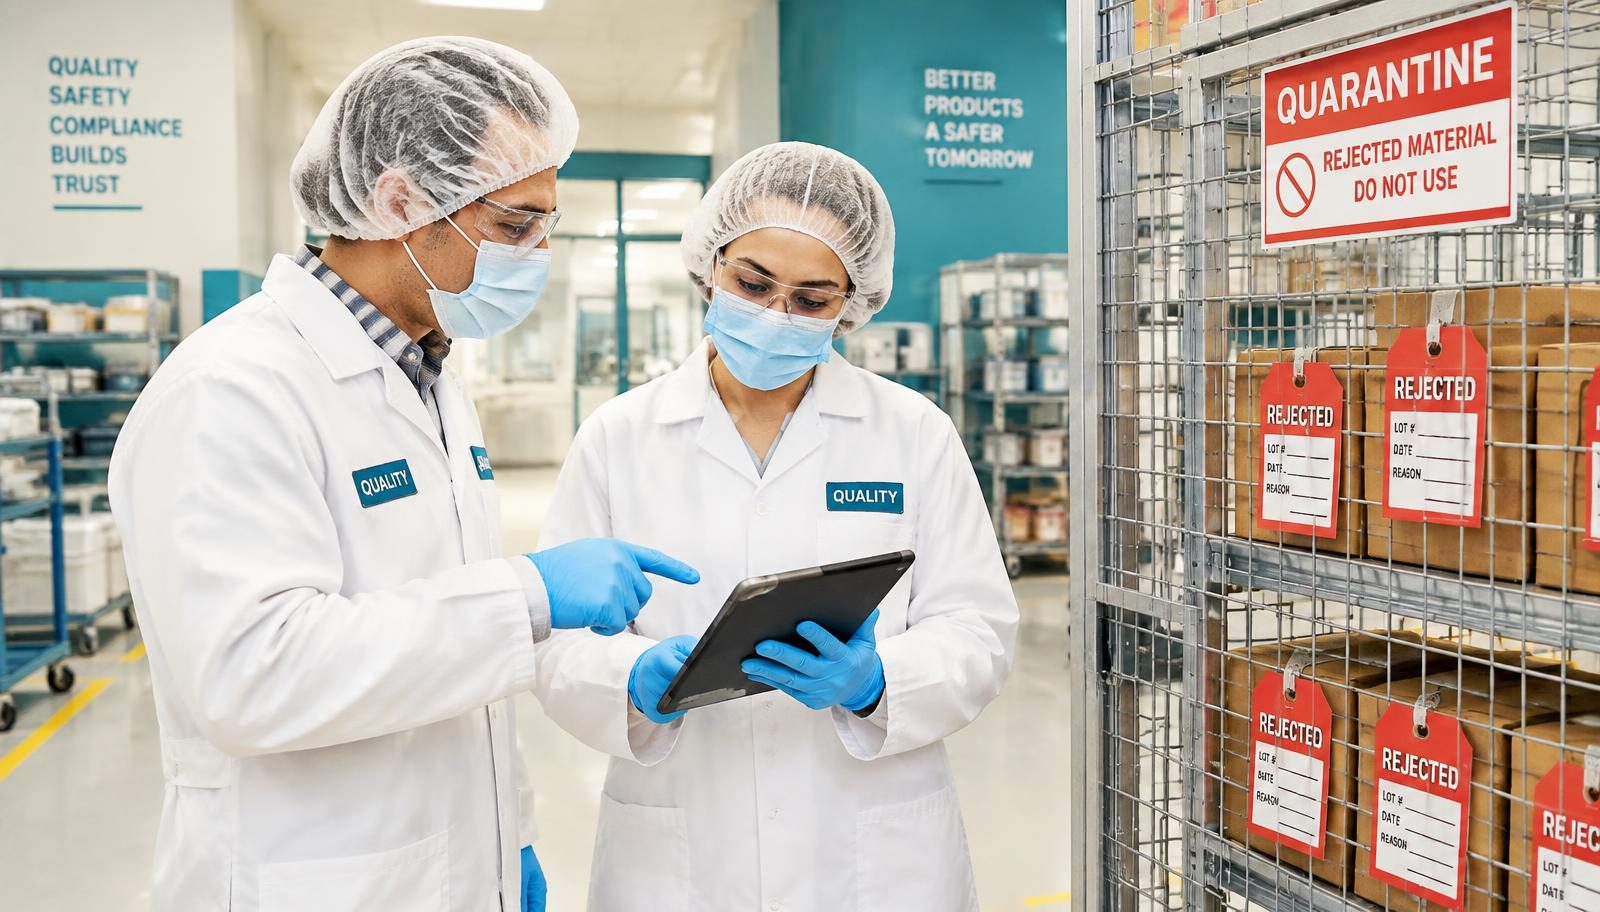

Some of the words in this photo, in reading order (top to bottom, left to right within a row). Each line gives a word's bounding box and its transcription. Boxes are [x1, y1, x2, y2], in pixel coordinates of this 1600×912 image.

[48, 56, 139, 77] QUALITY
[924, 68, 996, 91] BETTER
[1277, 36, 1494, 126] QUARANTINE
[49, 86, 130, 105] SAFETY
[924, 94, 1024, 119] PRODUCTS
[50, 116, 183, 137] COMPLIANCE
[925, 121, 940, 141] A
[944, 122, 1004, 143] SAFER
[51, 145, 127, 165] BUILDS
[1323, 138, 1402, 172] REJECTED
[1408, 121, 1497, 158] MATERIAL
[925, 147, 1034, 169] TOMORROW
[52, 174, 120, 194] TRUST
[1354, 177, 1377, 203] DO
[1383, 172, 1417, 198] NOT
[1423, 165, 1458, 193] USE
[1395, 375, 1476, 401] REJECTED
[1267, 404, 1334, 428] REJECTED
[1394, 422, 1408, 433] LOT
[1267, 444, 1280, 454] LOT
[360, 470, 409, 496] QUALITY
[1392, 467, 1422, 480] REASON
[833, 489, 898, 504] QUALITY
[1259, 711, 1322, 749] REJECTED
[1259, 751, 1270, 763] LOT
[1382, 747, 1459, 791] REJECTED
[1382, 790, 1396, 803] LOT
[1381, 810, 1401, 826] DATE
[1380, 832, 1408, 850] REASON
[1543, 860, 1559, 875] LOT
[1542, 884, 1565, 901] DATE
